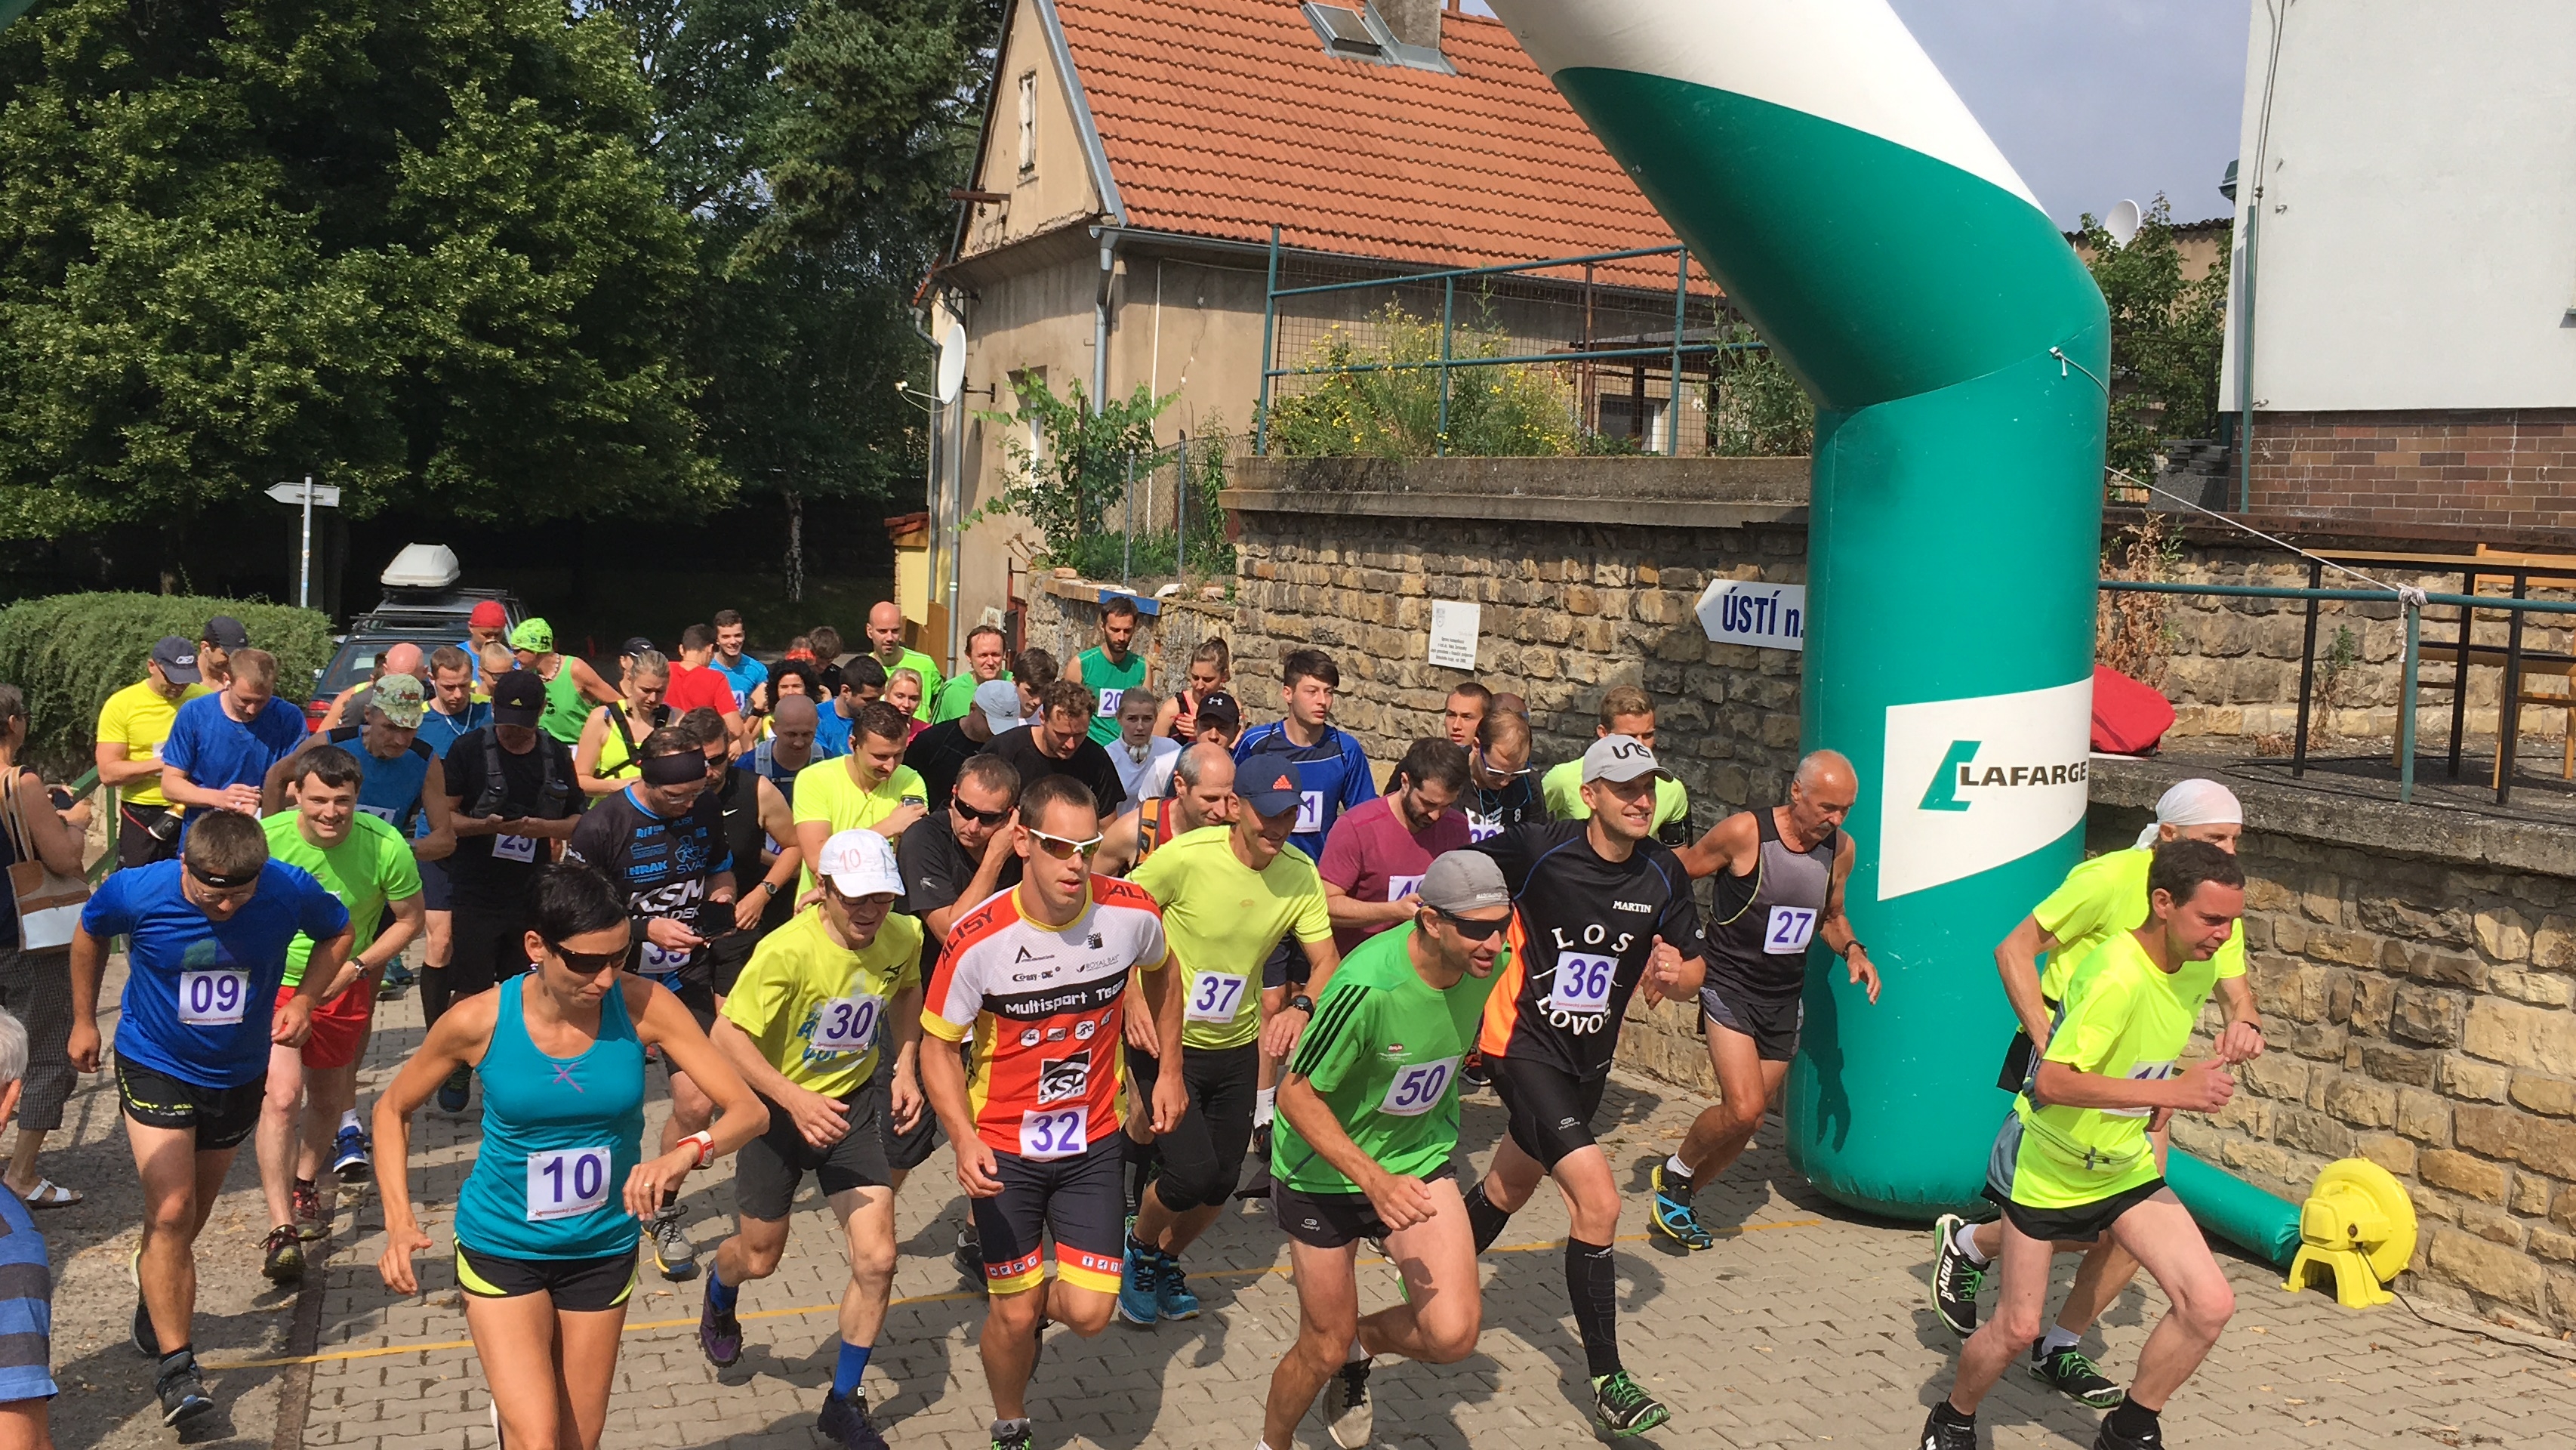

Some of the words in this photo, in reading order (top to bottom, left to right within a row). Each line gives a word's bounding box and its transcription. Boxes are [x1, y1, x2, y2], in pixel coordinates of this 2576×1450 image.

[1722, 586, 1781, 635] ÚSTÍ
[1960, 760, 2087, 787] LAFARGE
[1613, 901, 1652, 914] MARTIN
[1551, 924, 1635, 952] LOS
[1772, 911, 1812, 943] 27
[191, 974, 239, 1013] 09
[1005, 991, 1088, 1015] Multisport
[1095, 978, 1125, 1001] Team
[1196, 976, 1241, 1012] 37
[1564, 958, 1610, 999] 36
[826, 1001, 874, 1039] 30
[1395, 1064, 1446, 1106] 50
[1031, 1111, 1080, 1152] 32
[543, 1153, 602, 1203] 10
